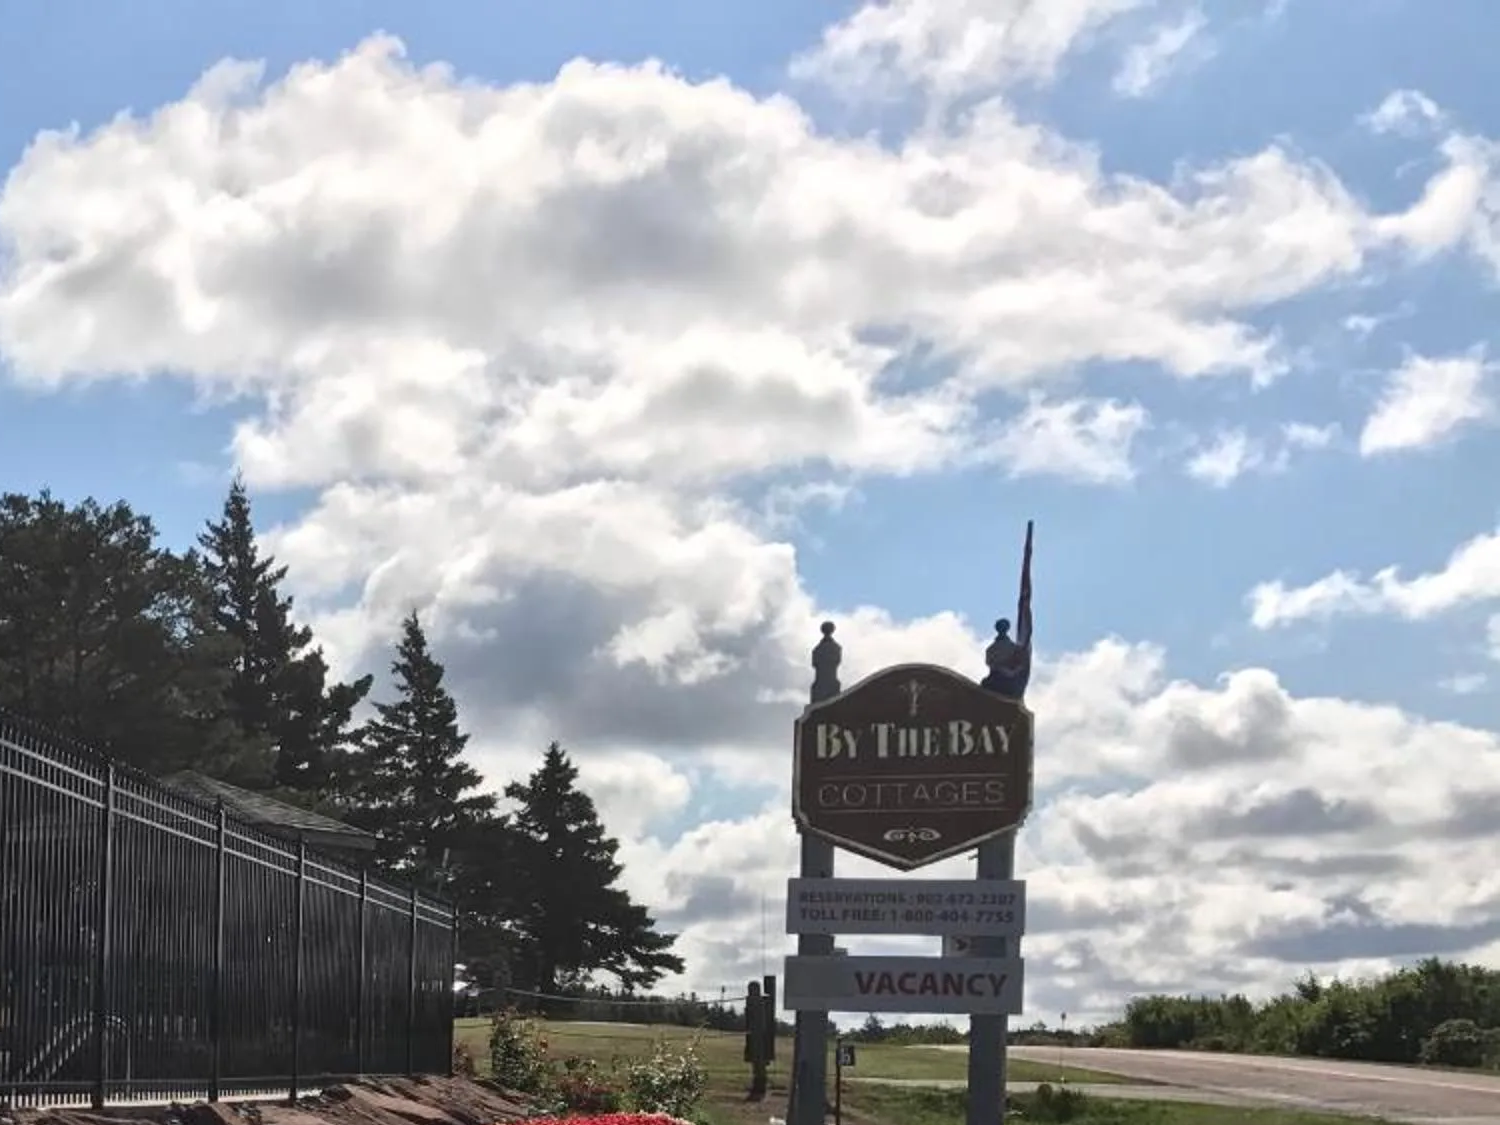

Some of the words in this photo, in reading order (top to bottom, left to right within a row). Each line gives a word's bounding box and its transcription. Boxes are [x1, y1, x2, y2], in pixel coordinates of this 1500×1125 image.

[817, 723, 862, 758] BY
[871, 722, 941, 758] THE
[948, 719, 1015, 756] BAY
[818, 780, 1005, 808] COTTAGES
[801, 908, 837, 921] TOLL
[841, 909, 886, 921] FREE:
[854, 970, 1008, 996] VACANCY
